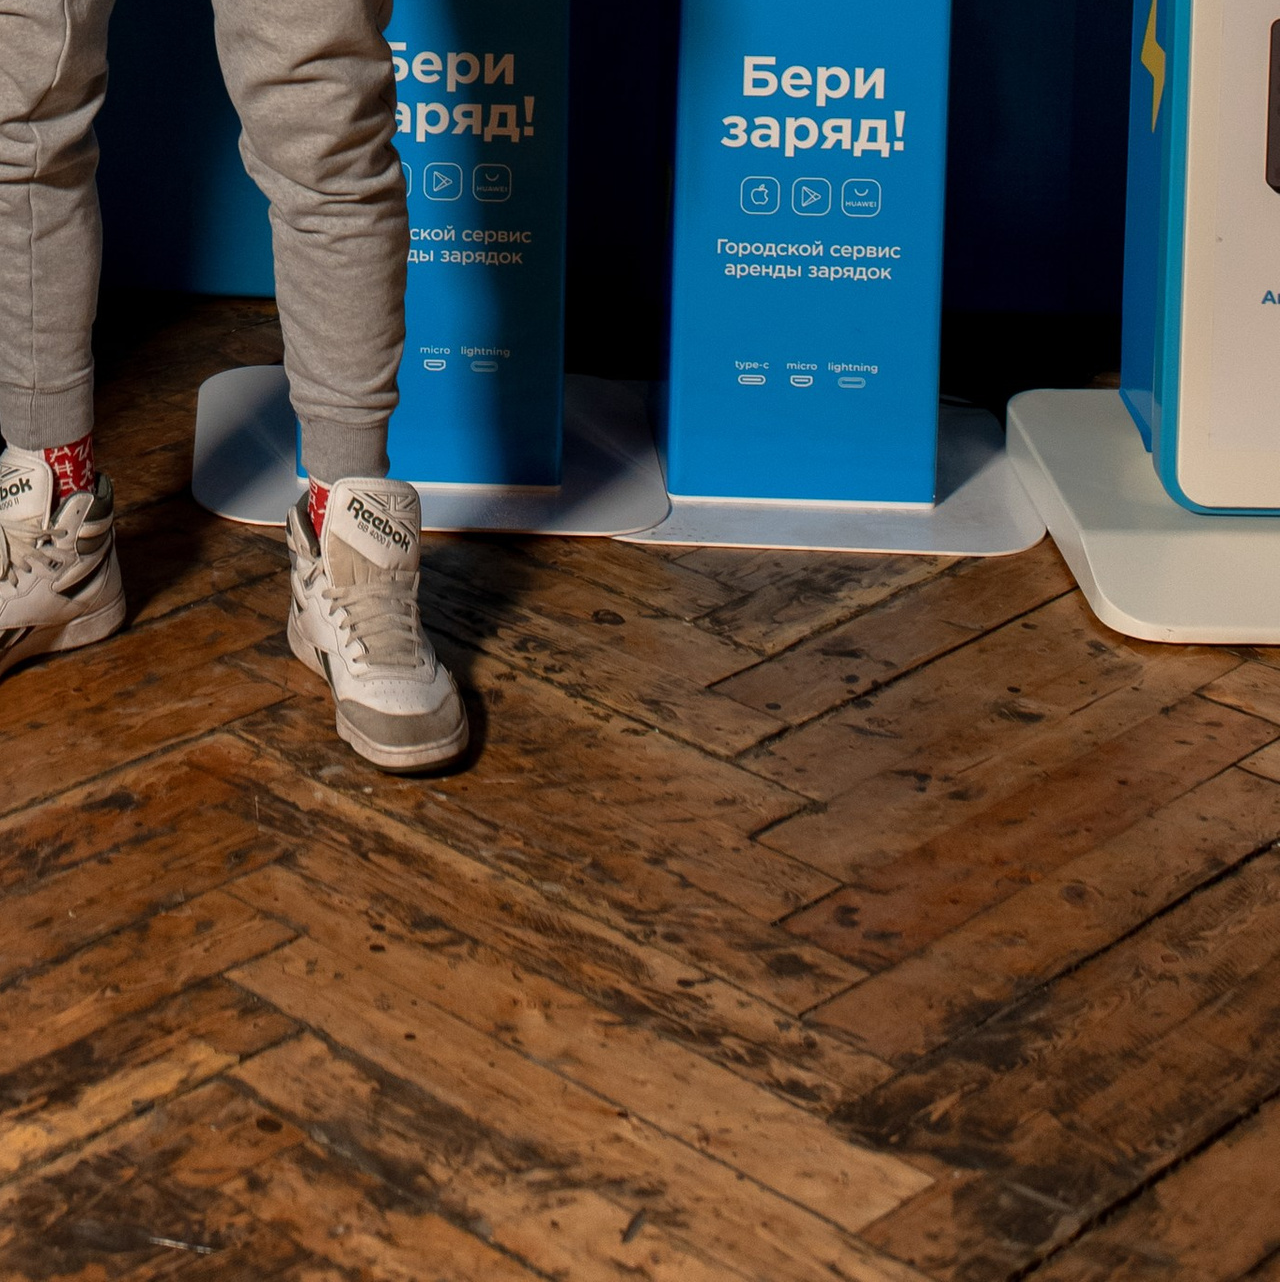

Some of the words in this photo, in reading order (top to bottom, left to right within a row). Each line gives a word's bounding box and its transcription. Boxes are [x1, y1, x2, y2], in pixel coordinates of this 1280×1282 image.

[742, 55, 886, 107] Бери
[394, 94, 536, 143] аряд!
[720, 109, 907, 158] заряд!
[475, 184, 509, 193] HUAWEI
[844, 200, 878, 208] HUAWEI
[461, 227, 533, 246] сервис
[439, 248, 524, 267] зарядок
[716, 238, 824, 258] Городской
[829, 241, 902, 261] сервис
[724, 262, 802, 279] аренды
[808, 263, 893, 282] зарядок
[419, 346, 451, 355] micro
[460, 345, 511, 358] lightning
[734, 360, 770, 371] type-c
[786, 361, 818, 371] micro
[827, 362, 879, 375] lightning
[346, 496, 411, 555] Reebok
[370, 529, 388, 548] 4000
